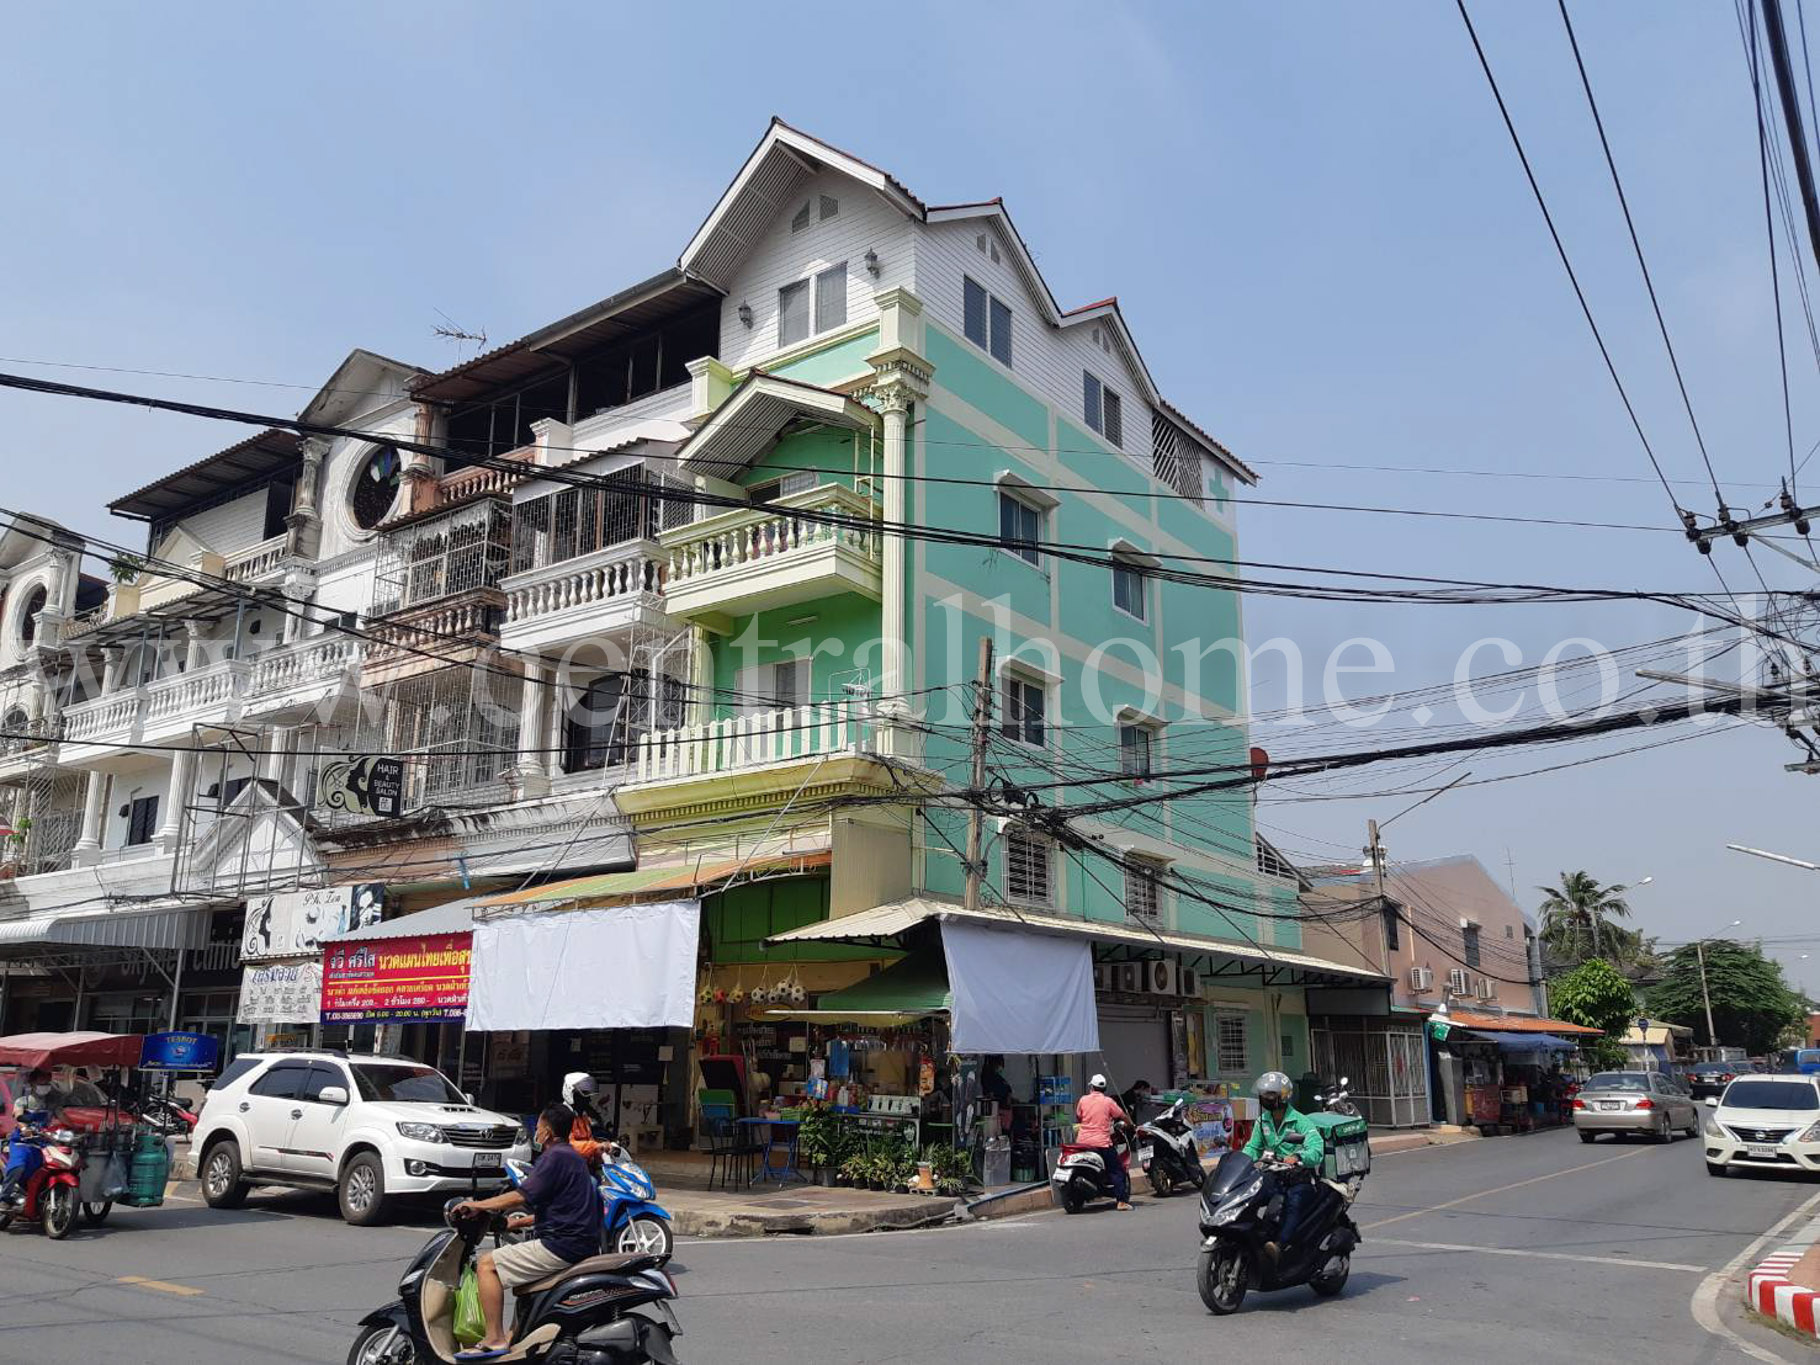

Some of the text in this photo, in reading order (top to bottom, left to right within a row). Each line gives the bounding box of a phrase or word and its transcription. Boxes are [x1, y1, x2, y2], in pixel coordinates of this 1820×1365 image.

[377, 763, 399, 775] HAIR
[374, 779, 400, 789] BEAUTY
[376, 787, 397, 796] SALON
